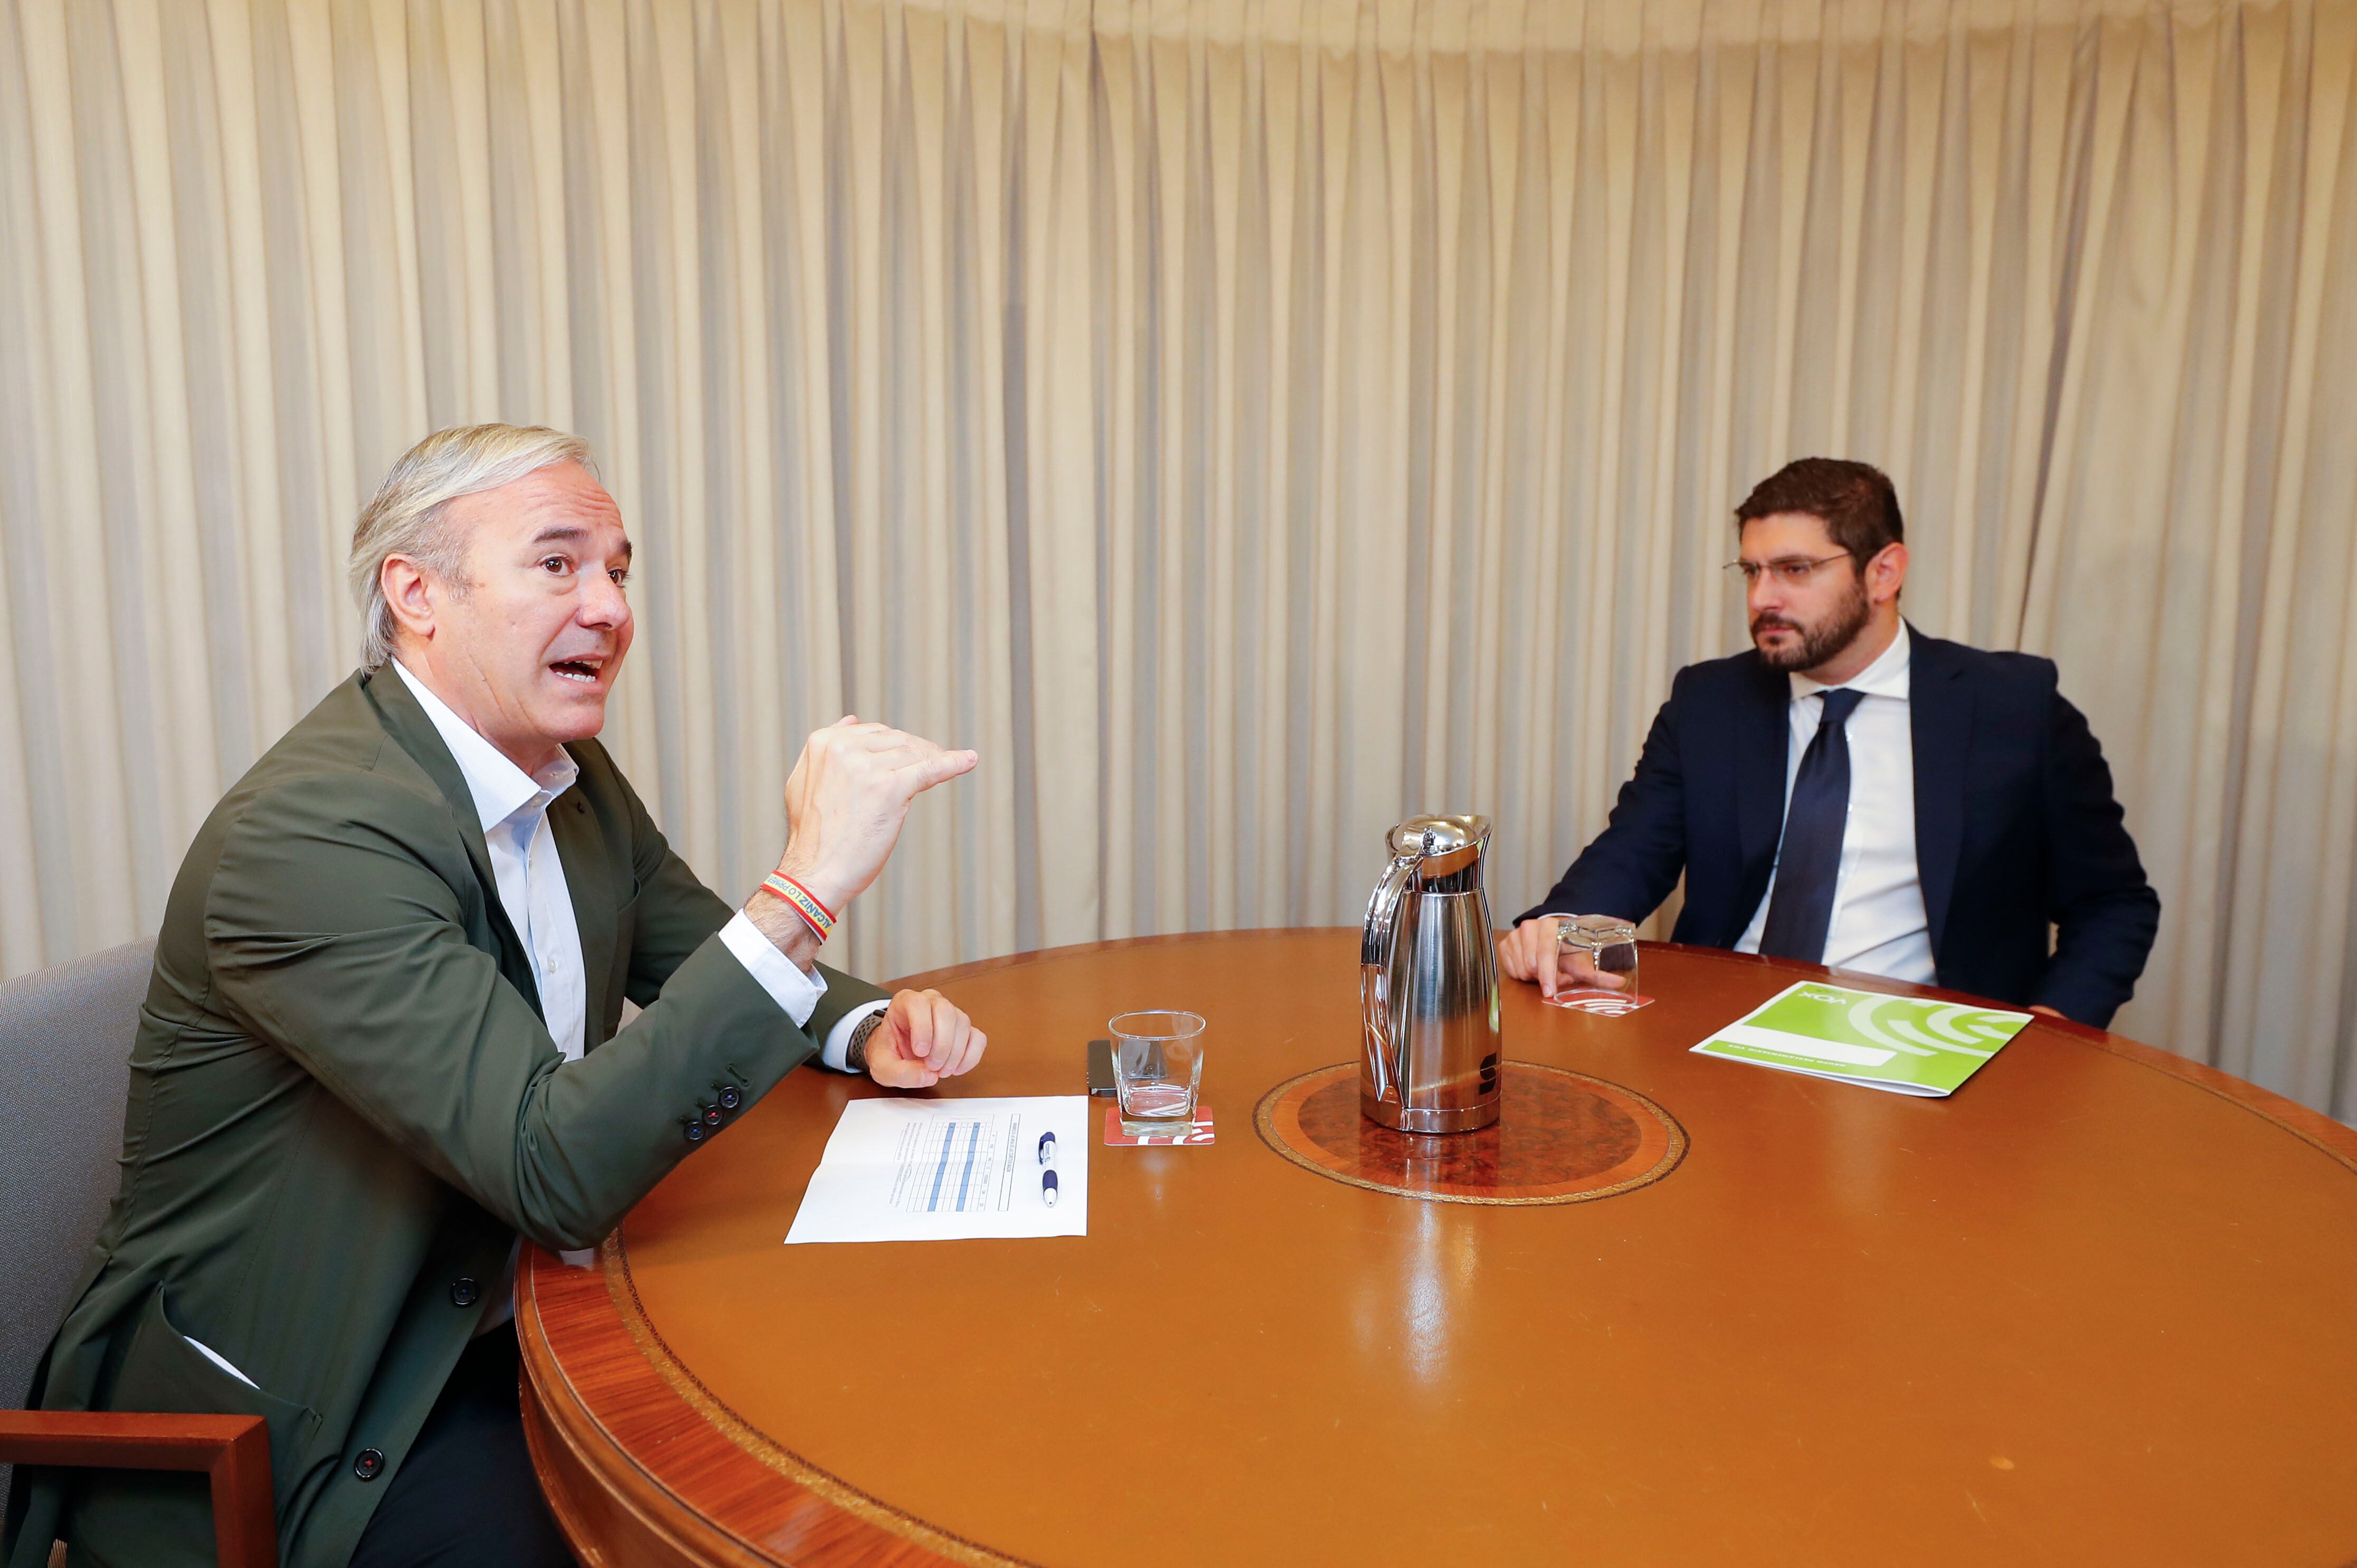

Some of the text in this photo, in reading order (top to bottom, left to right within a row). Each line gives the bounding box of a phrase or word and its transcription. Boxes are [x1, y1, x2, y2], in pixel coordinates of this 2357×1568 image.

[789, 888, 802, 899] LO
[799, 896, 832, 929] ALCAÑIZ
[1798, 992, 1846, 1004] VOX
[1748, 1048, 1814, 1062] PARLAMENTARIO
